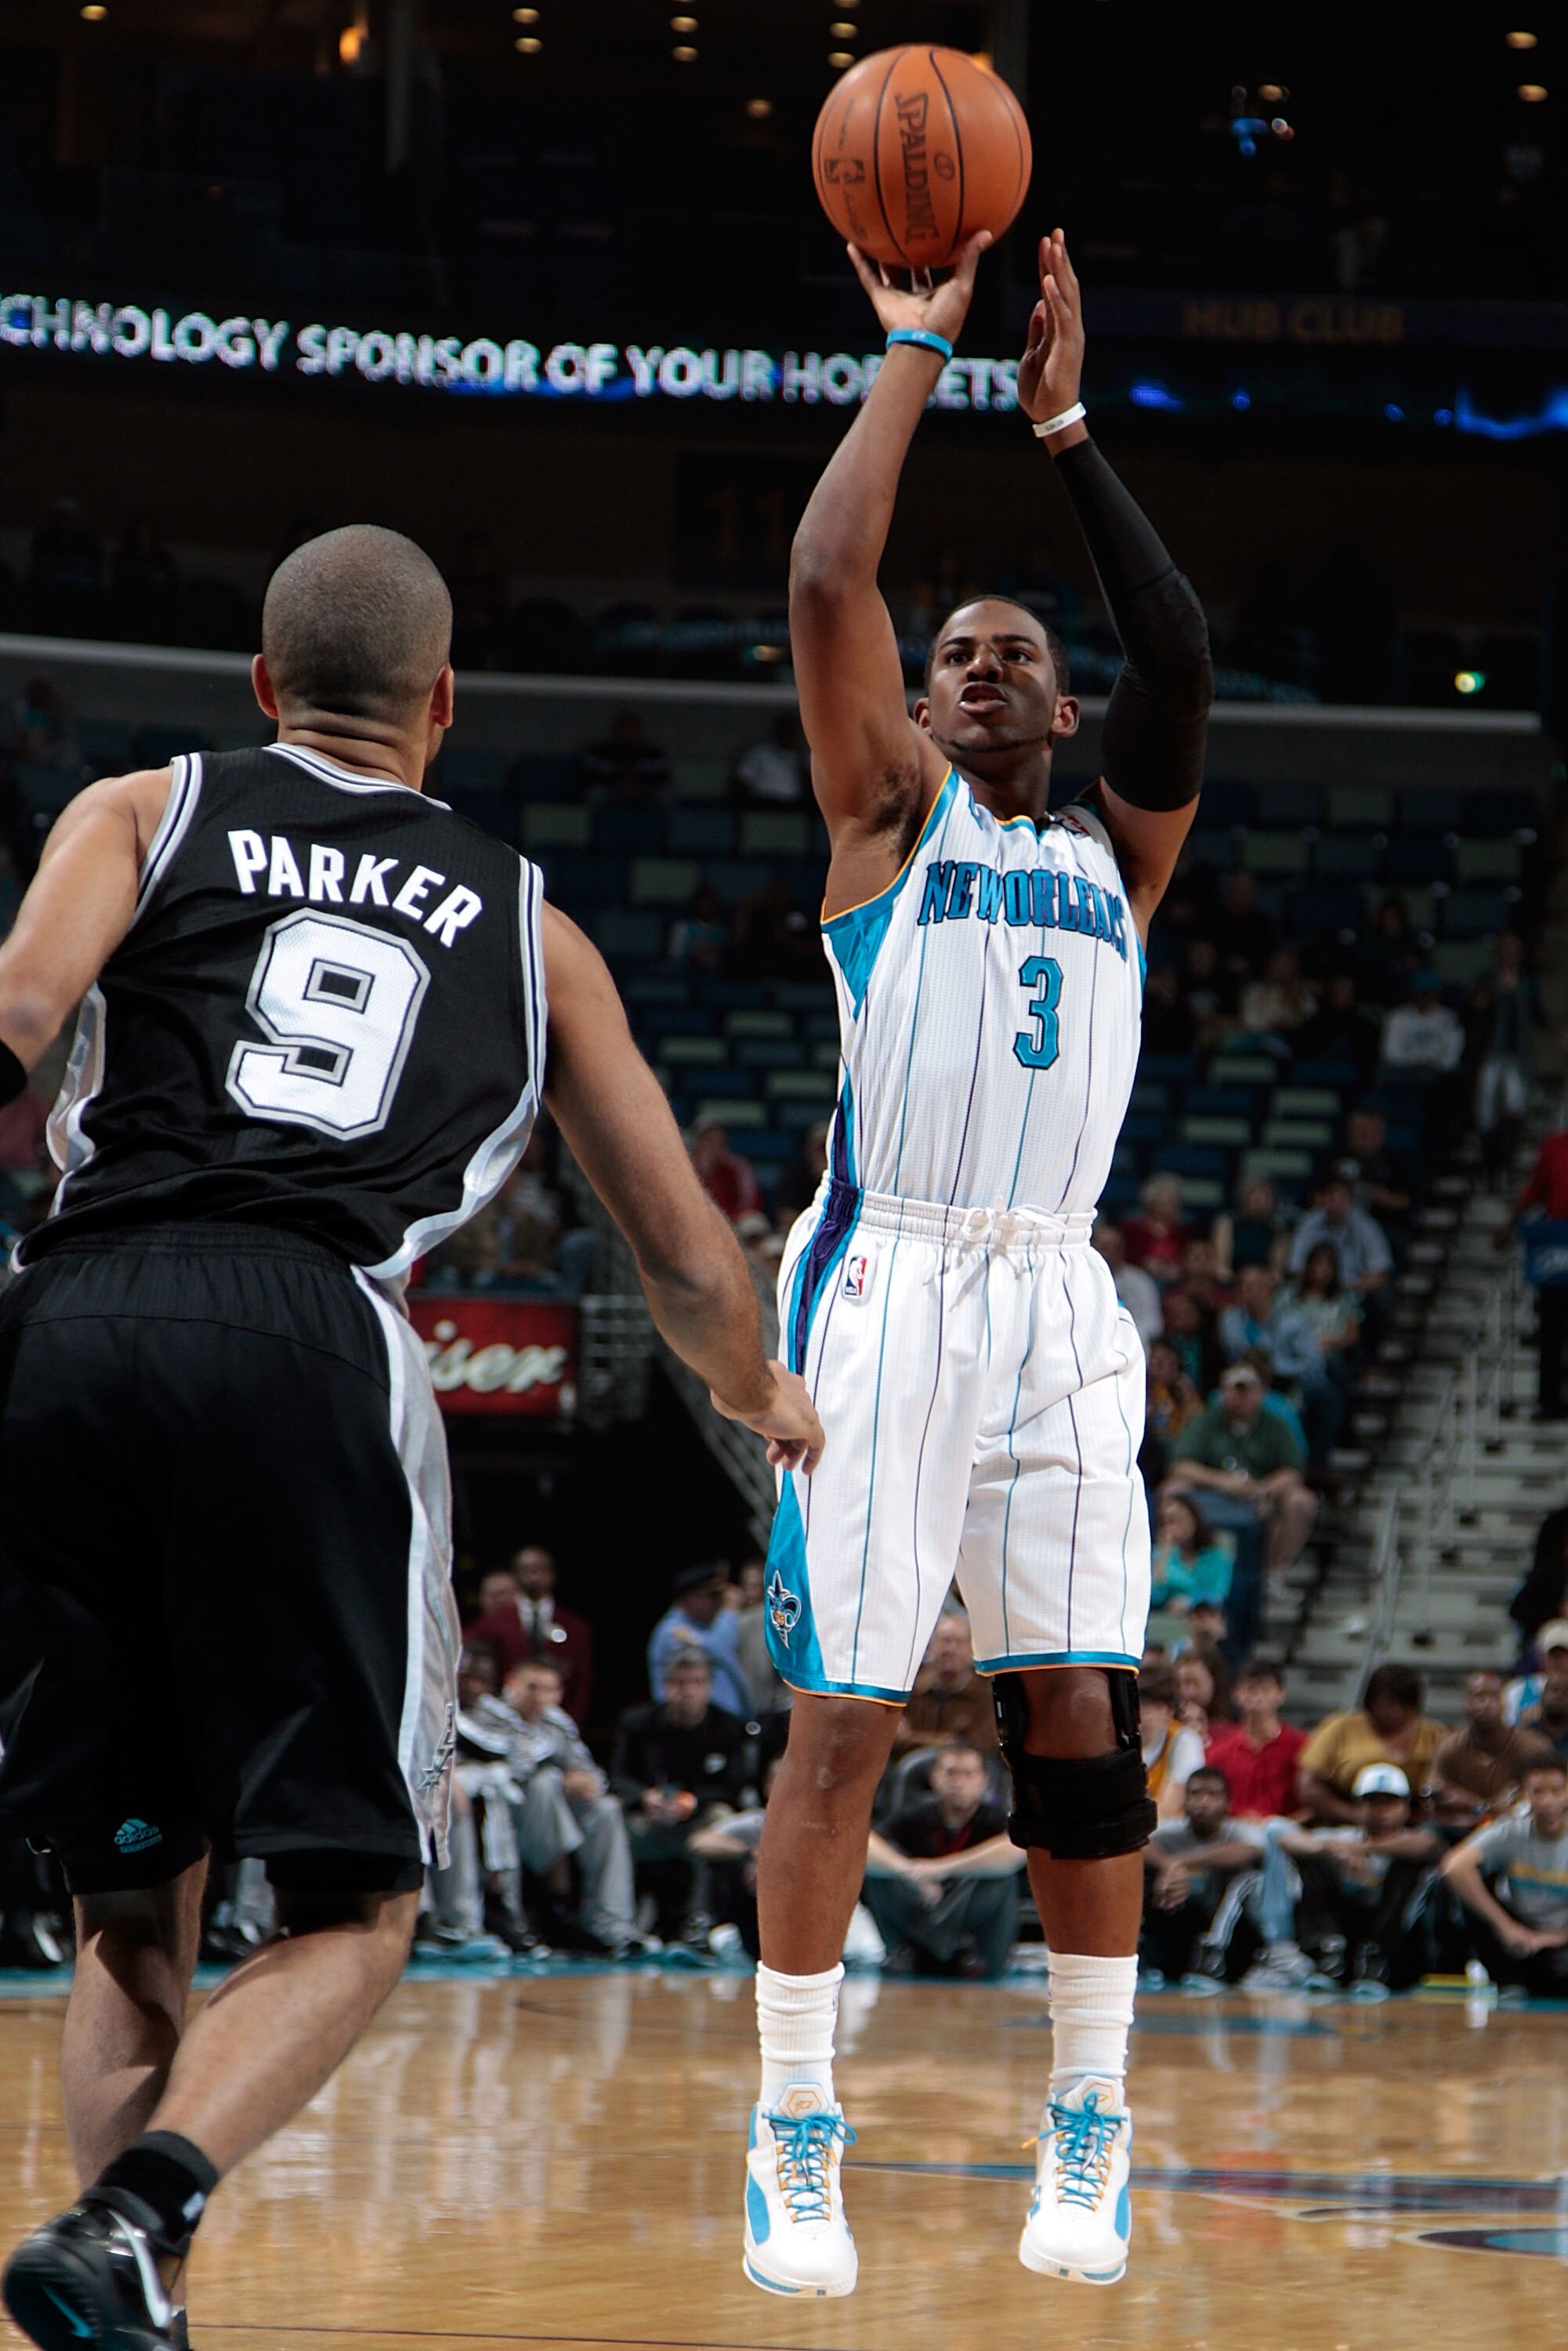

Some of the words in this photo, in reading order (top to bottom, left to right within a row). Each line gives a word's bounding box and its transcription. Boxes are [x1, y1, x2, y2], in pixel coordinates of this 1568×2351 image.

[297, 324, 540, 392] SPONSOR
[545, 342, 617, 393] OF
[626, 346, 773, 403] YOUR
[1289, 301, 1406, 347] CLUB
[227, 829, 483, 948] PARKER
[225, 906, 432, 1142] 9
[1012, 955, 1064, 1070] 3
[114, 1825, 160, 1845] adidas
